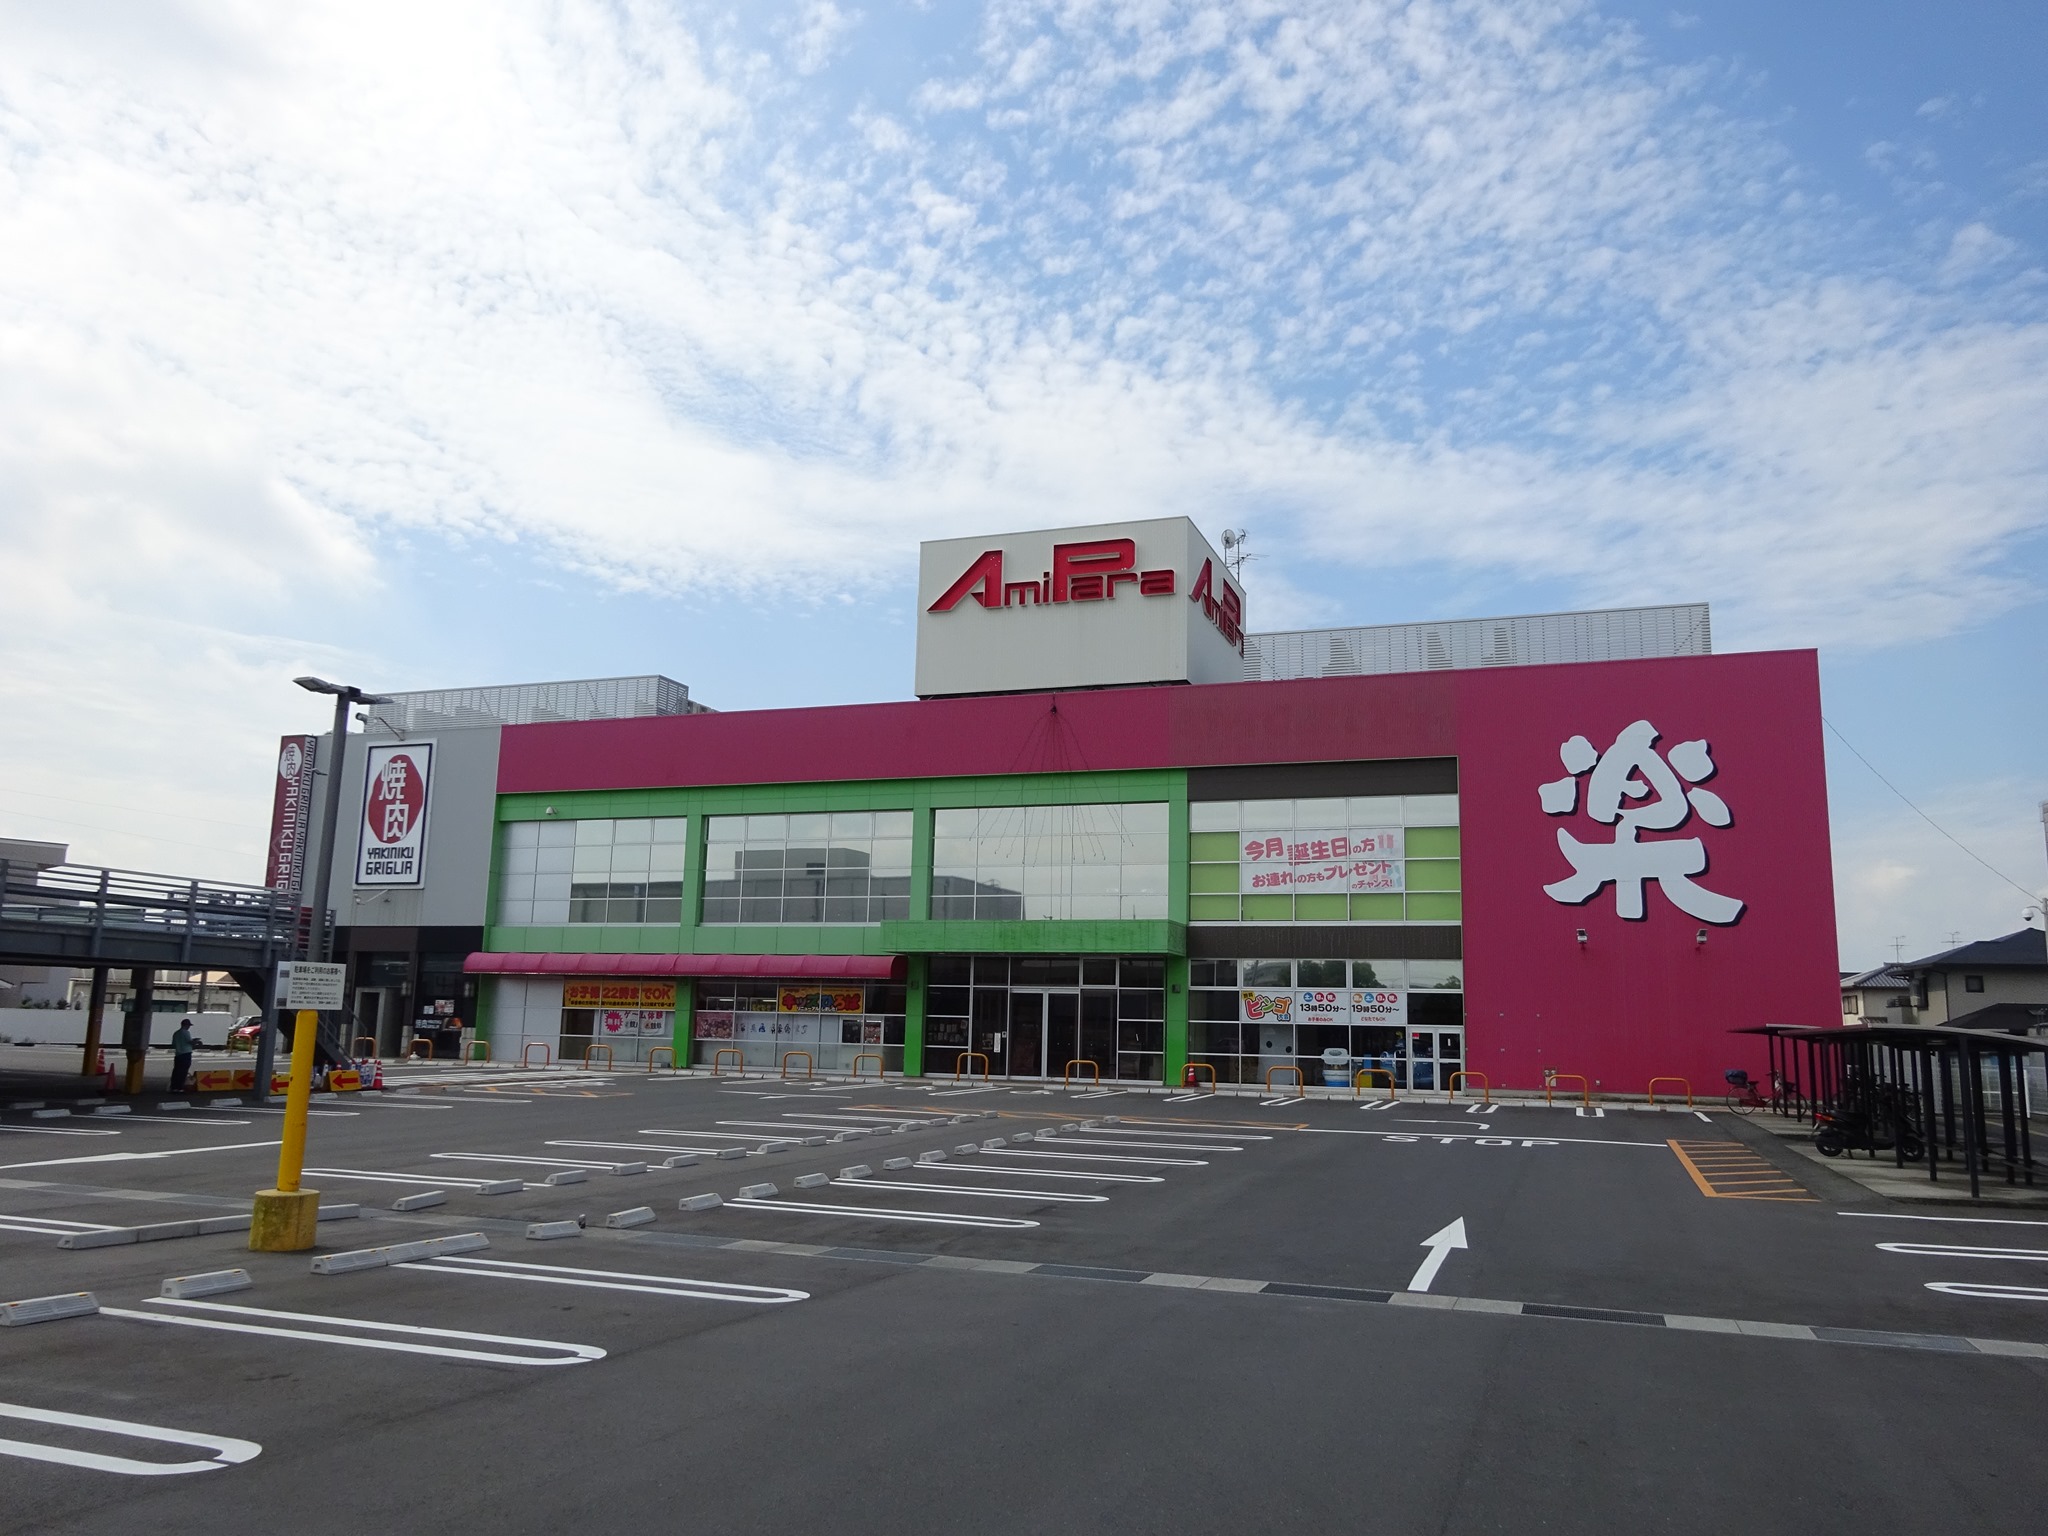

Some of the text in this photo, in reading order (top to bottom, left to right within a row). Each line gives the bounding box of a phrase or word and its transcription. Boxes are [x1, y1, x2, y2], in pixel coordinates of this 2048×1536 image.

[927, 538, 1175, 613] AmiPara
[280, 776, 300, 849] YAKINIKU
[379, 760, 410, 841] 焼肉
[1538, 719, 1745, 925] 楽
[365, 861, 413, 875] GRIGLIA
[367, 847, 414, 859] YAKINIKU
[1245, 994, 1292, 1019] ビンゴ
[1382, 1135, 1560, 1148] STOP
